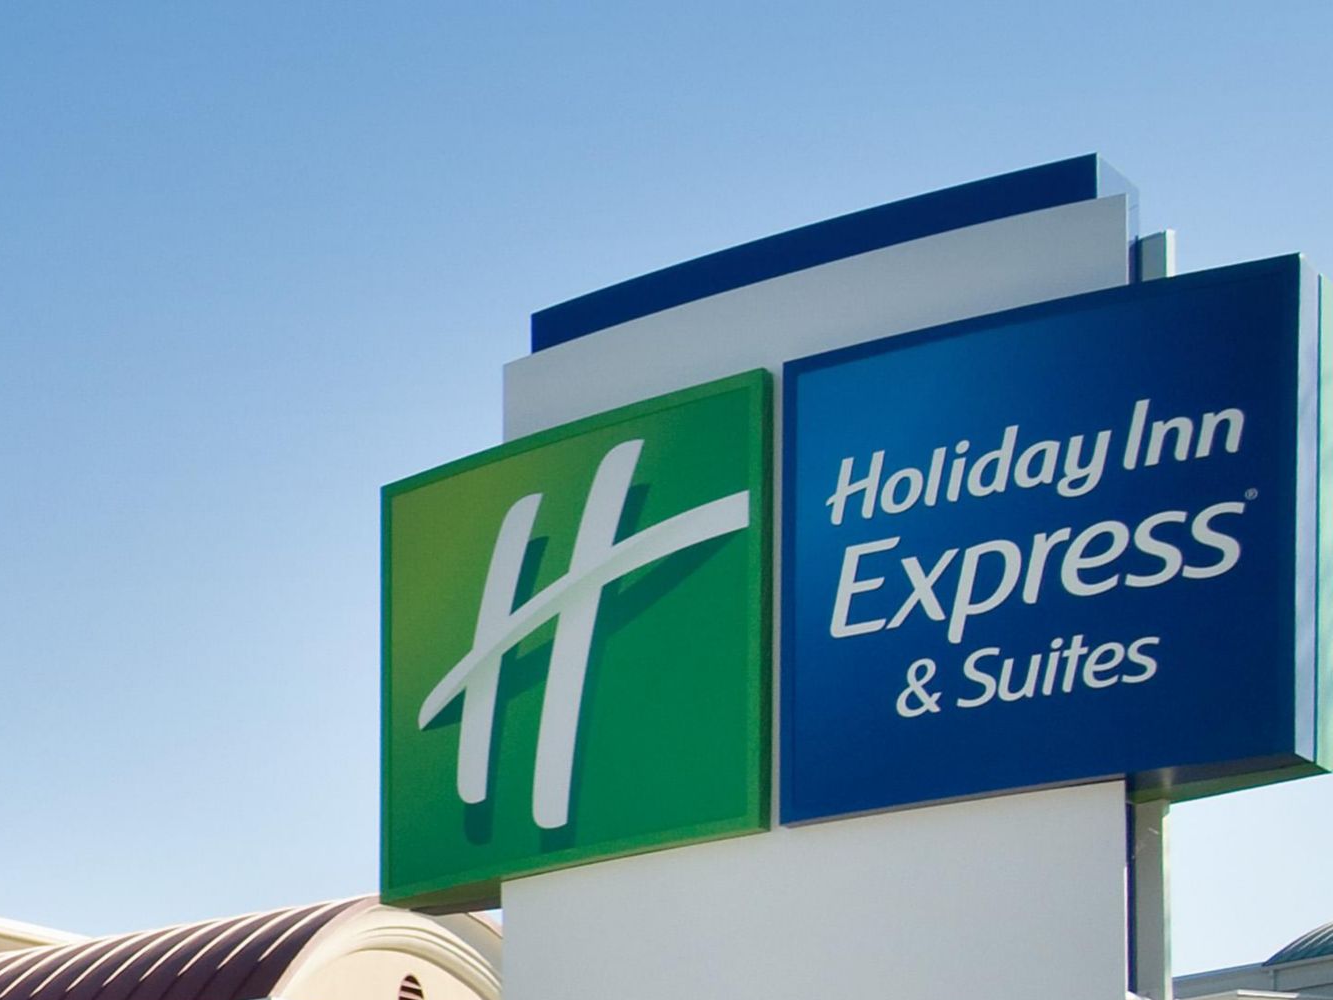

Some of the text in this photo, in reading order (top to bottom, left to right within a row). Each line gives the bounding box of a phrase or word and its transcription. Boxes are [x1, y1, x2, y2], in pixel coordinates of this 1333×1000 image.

[826, 398, 1245, 525] Holiday Inn
[895, 634, 1161, 718] & Suites
